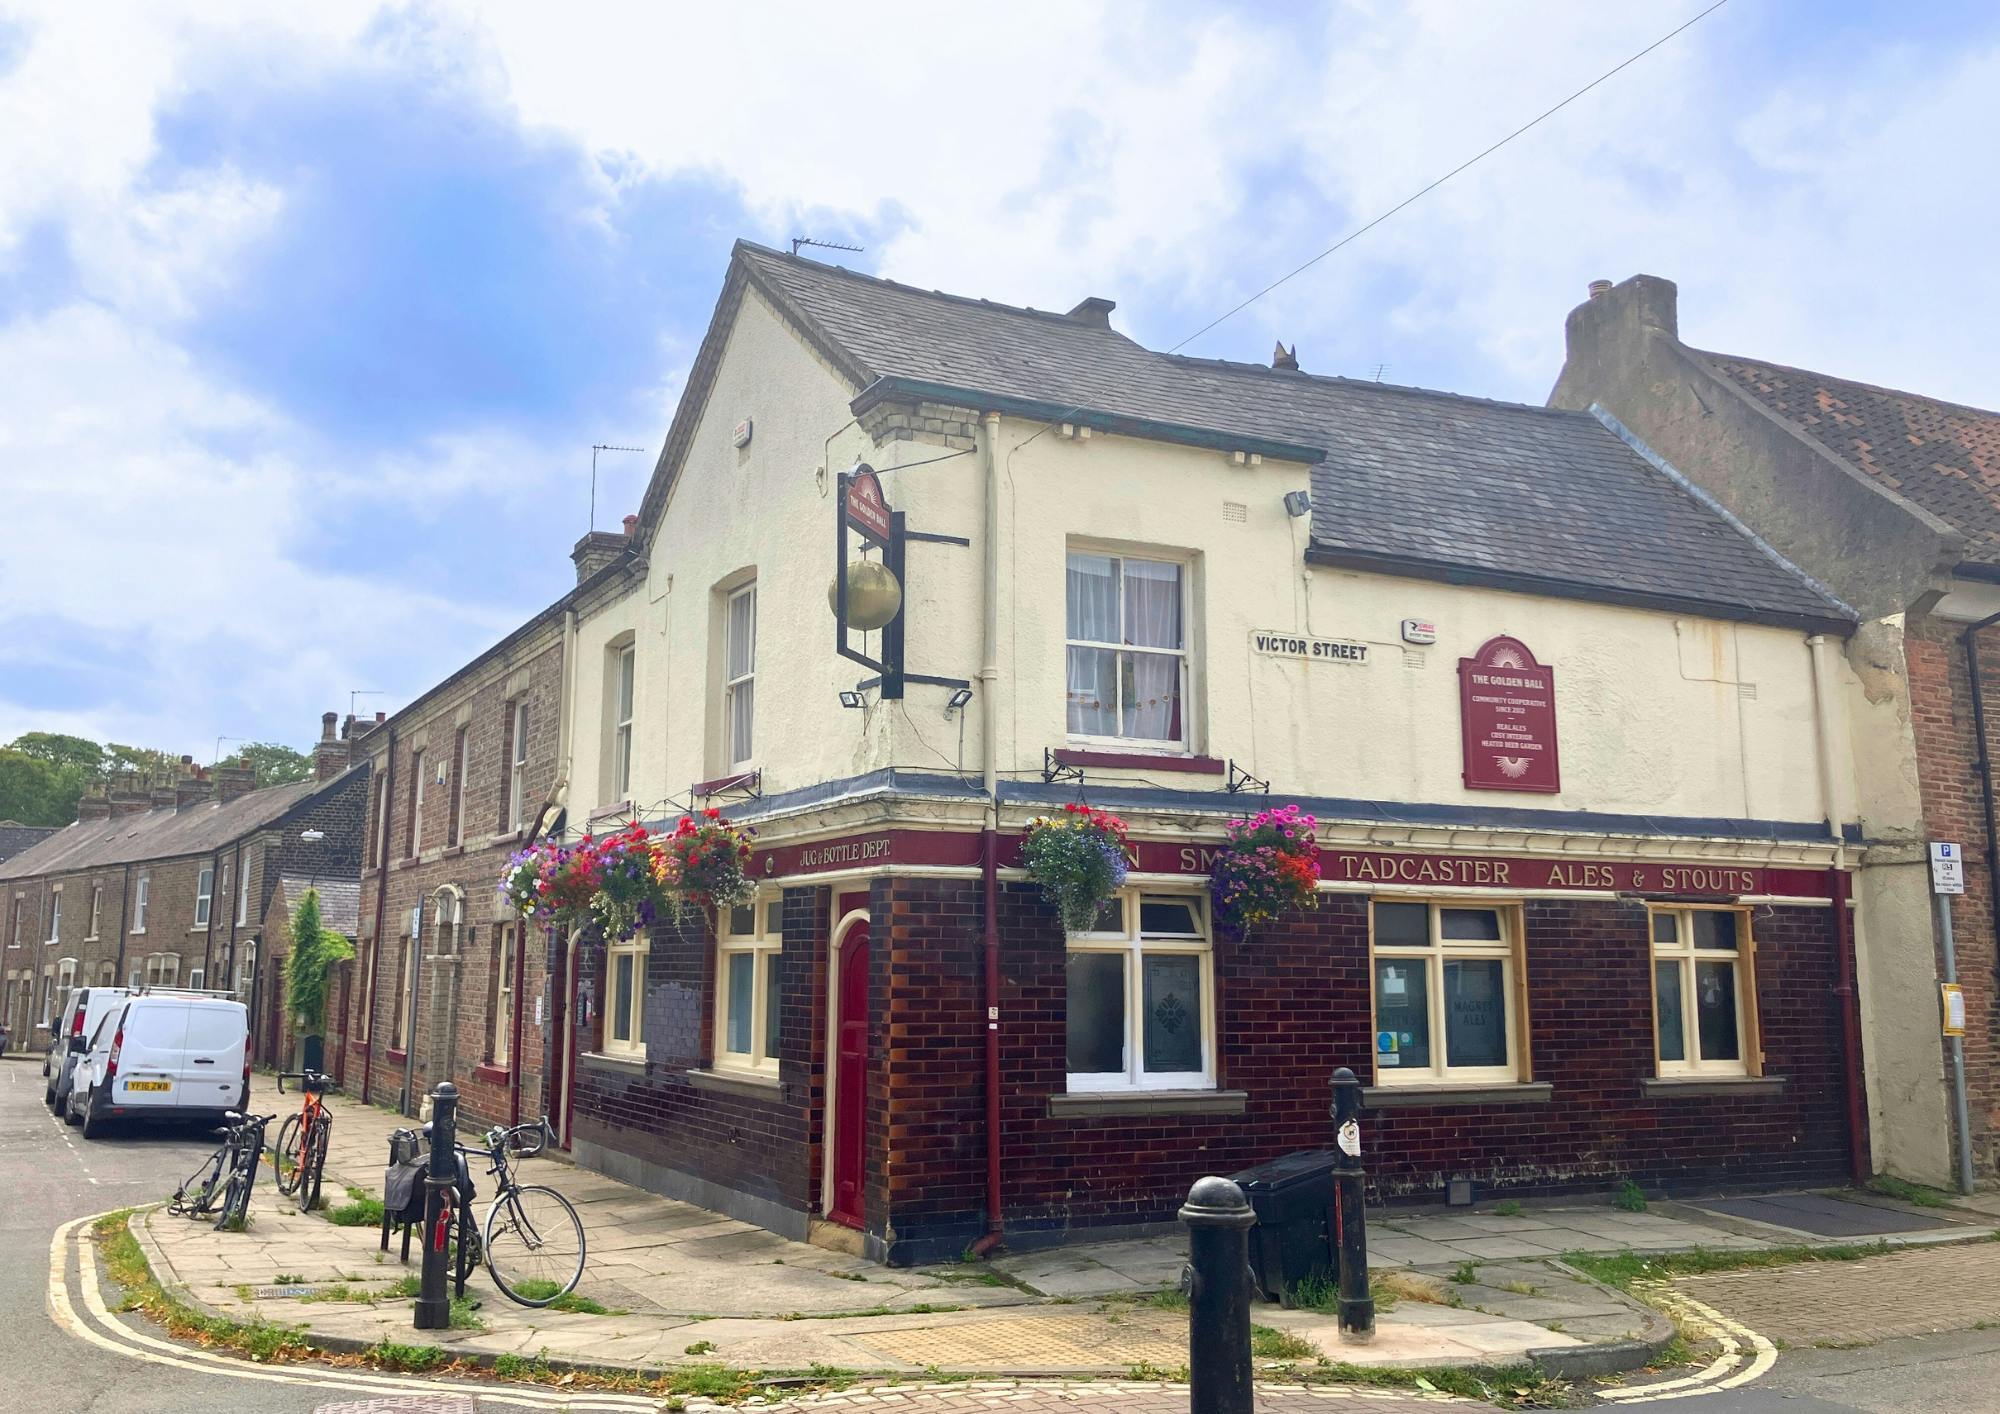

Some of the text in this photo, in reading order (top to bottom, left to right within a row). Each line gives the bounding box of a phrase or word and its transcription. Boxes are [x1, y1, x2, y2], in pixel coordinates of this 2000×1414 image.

[1256, 636, 1367, 660] VICTOR STREET
[1472, 674, 1545, 689] THE GOLDEN BALL
[1472, 695, 1507, 704] COMMUNITY
[800, 839, 891, 867] JUG & BOTTLE DEPT.
[1339, 855, 1754, 891] TADCASTER ALES & STOUTS
